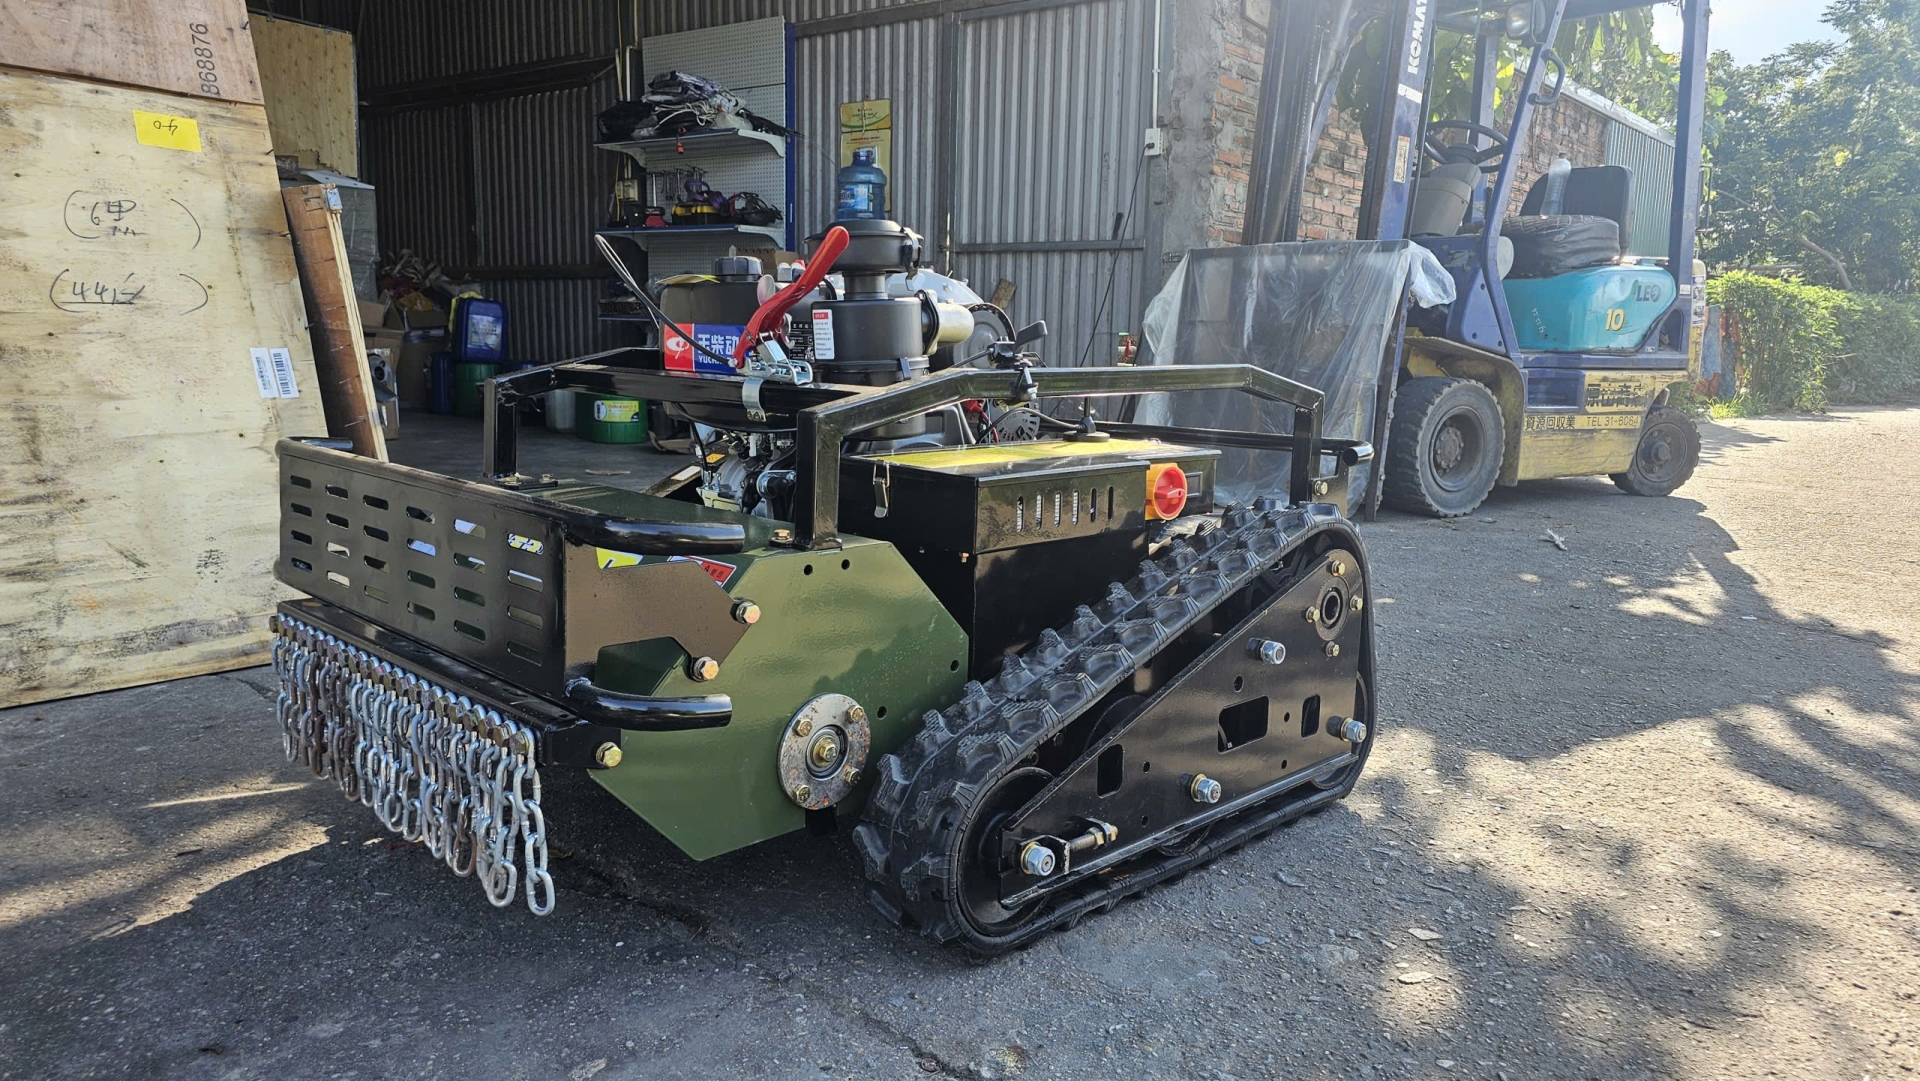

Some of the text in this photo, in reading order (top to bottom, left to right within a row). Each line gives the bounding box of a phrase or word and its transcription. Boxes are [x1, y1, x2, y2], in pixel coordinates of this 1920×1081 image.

[189, 22, 221, 97] 868876
[1605, 308, 1625, 332] 10
[697, 333, 740, 356] 玉柴动
[1586, 414, 1639, 427] TEL 31-6064
